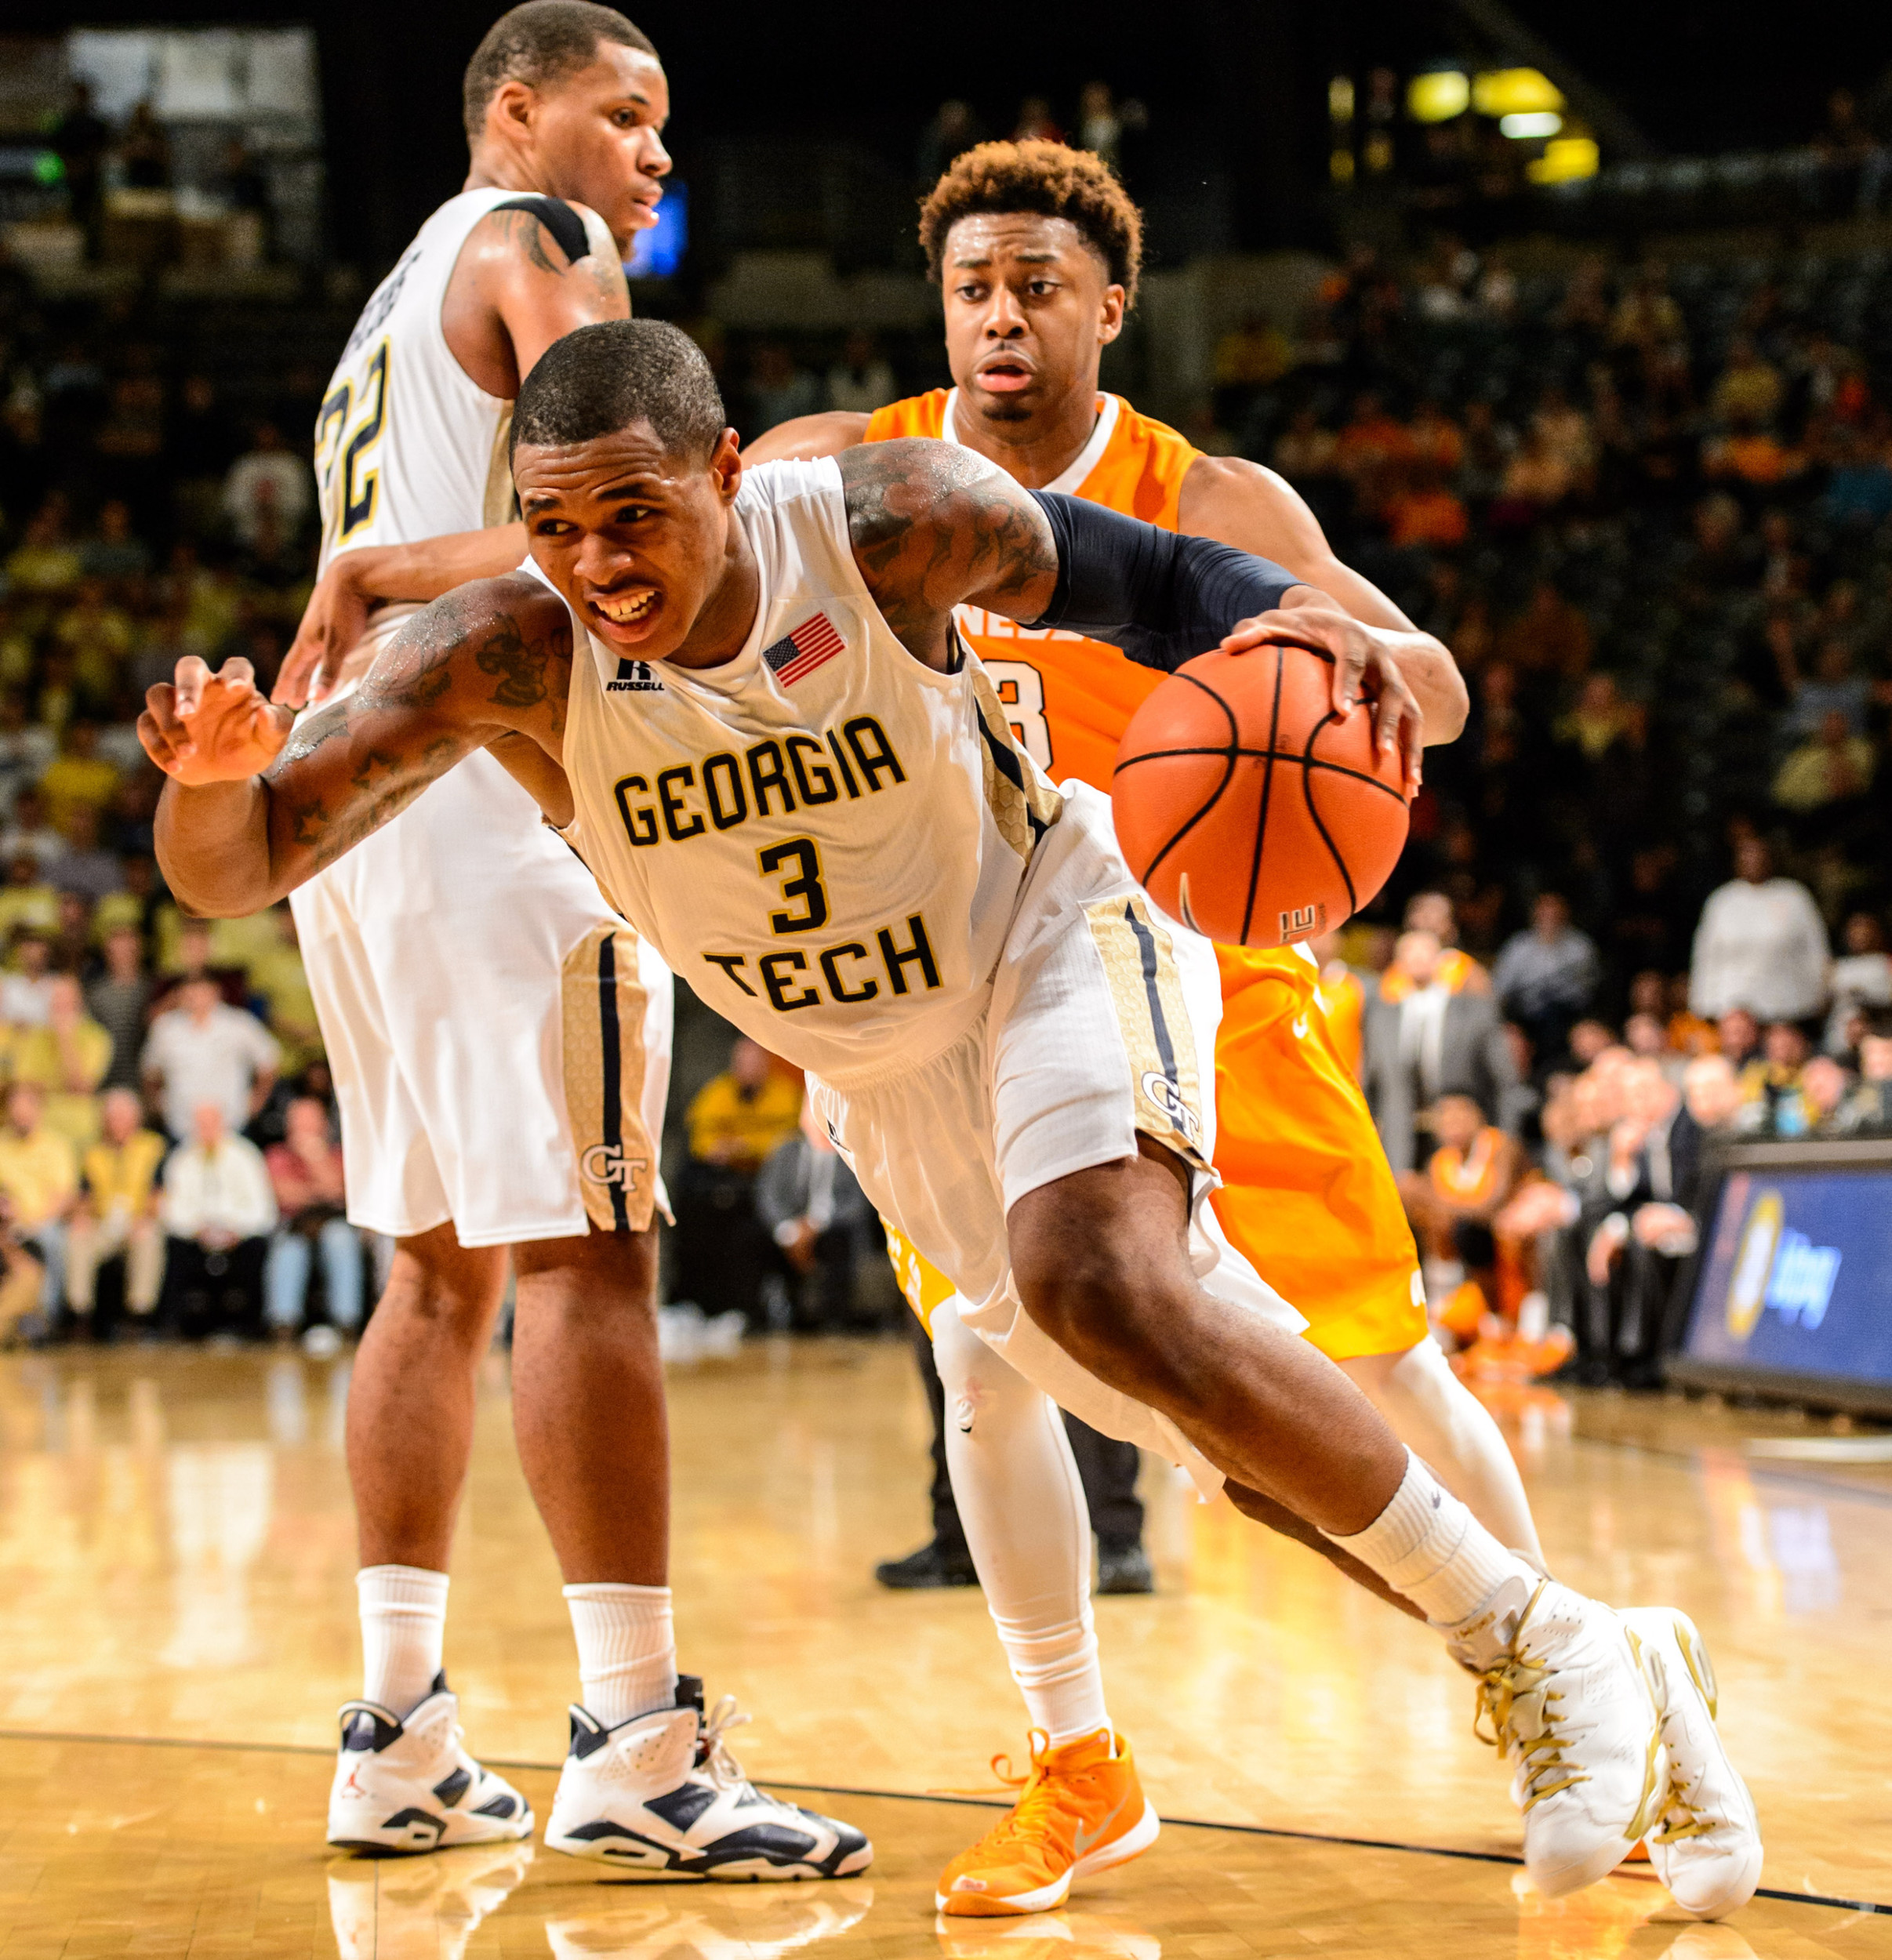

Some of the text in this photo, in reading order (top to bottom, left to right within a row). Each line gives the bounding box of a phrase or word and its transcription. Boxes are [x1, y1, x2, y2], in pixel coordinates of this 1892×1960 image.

[315, 334, 392, 546] 22
[606, 681, 665, 691] RUSSELL
[613, 713, 909, 848] GEORGIA
[756, 833, 830, 936] 3
[700, 912, 942, 1012] TECH
[581, 1145, 647, 1191] GT
